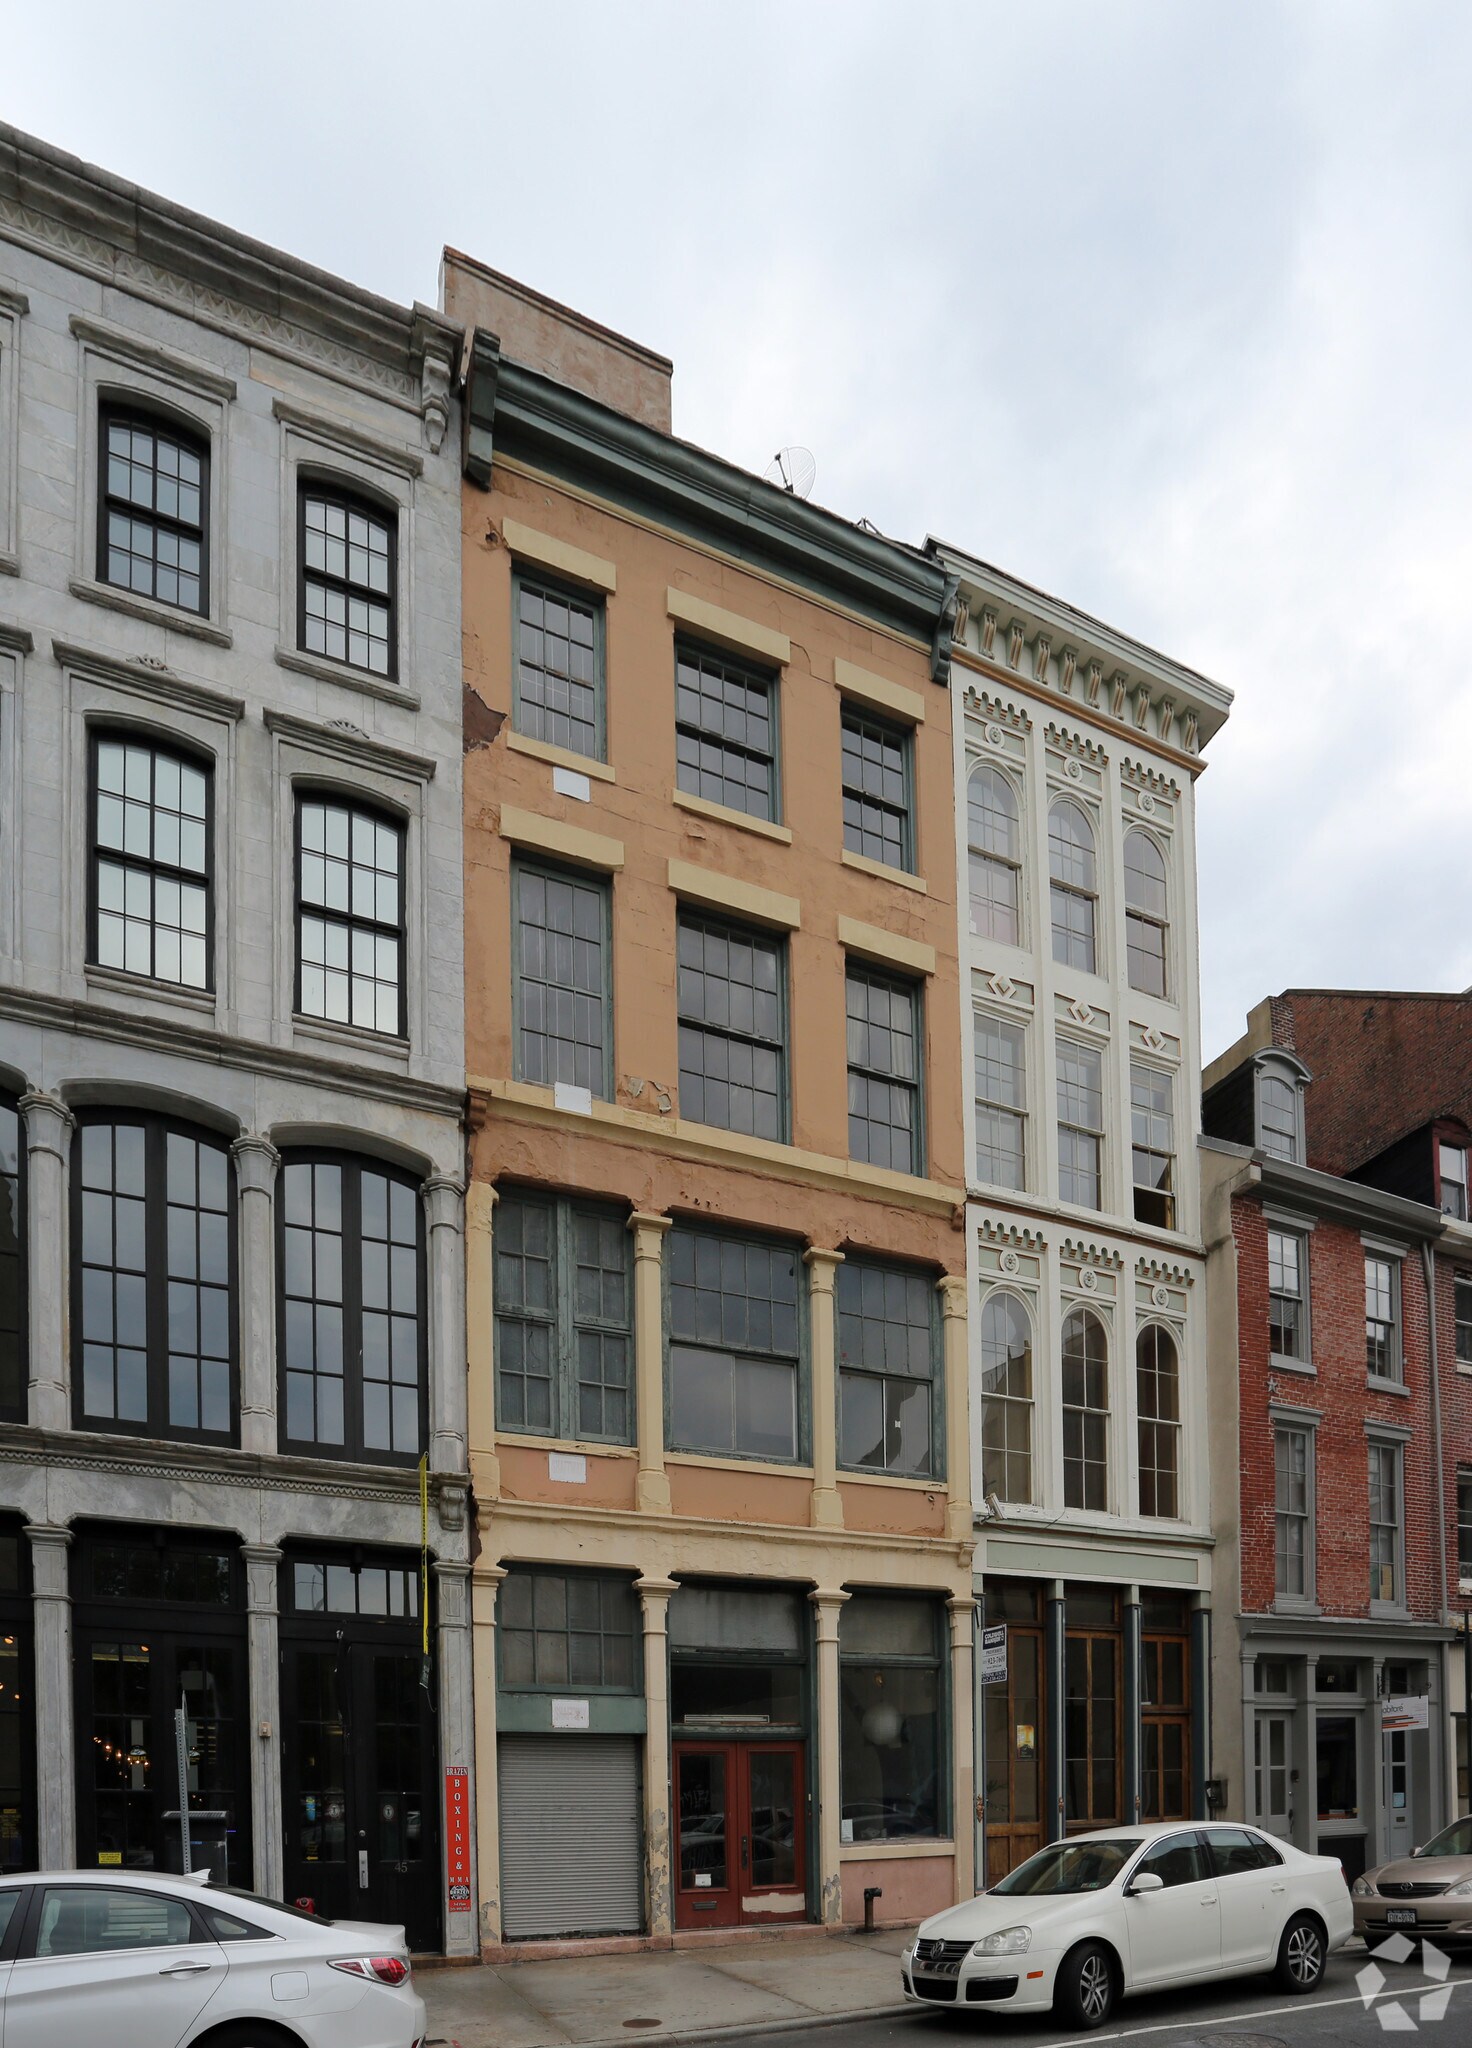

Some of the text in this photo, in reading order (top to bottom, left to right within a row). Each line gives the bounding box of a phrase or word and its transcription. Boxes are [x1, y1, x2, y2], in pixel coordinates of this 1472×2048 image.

[985, 1630, 1004, 1639] COLDWELL
[446, 1767, 468, 1776] BRAZEN
[454, 1778, 462, 1856] BOXING
[394, 1862, 408, 1873] 45
